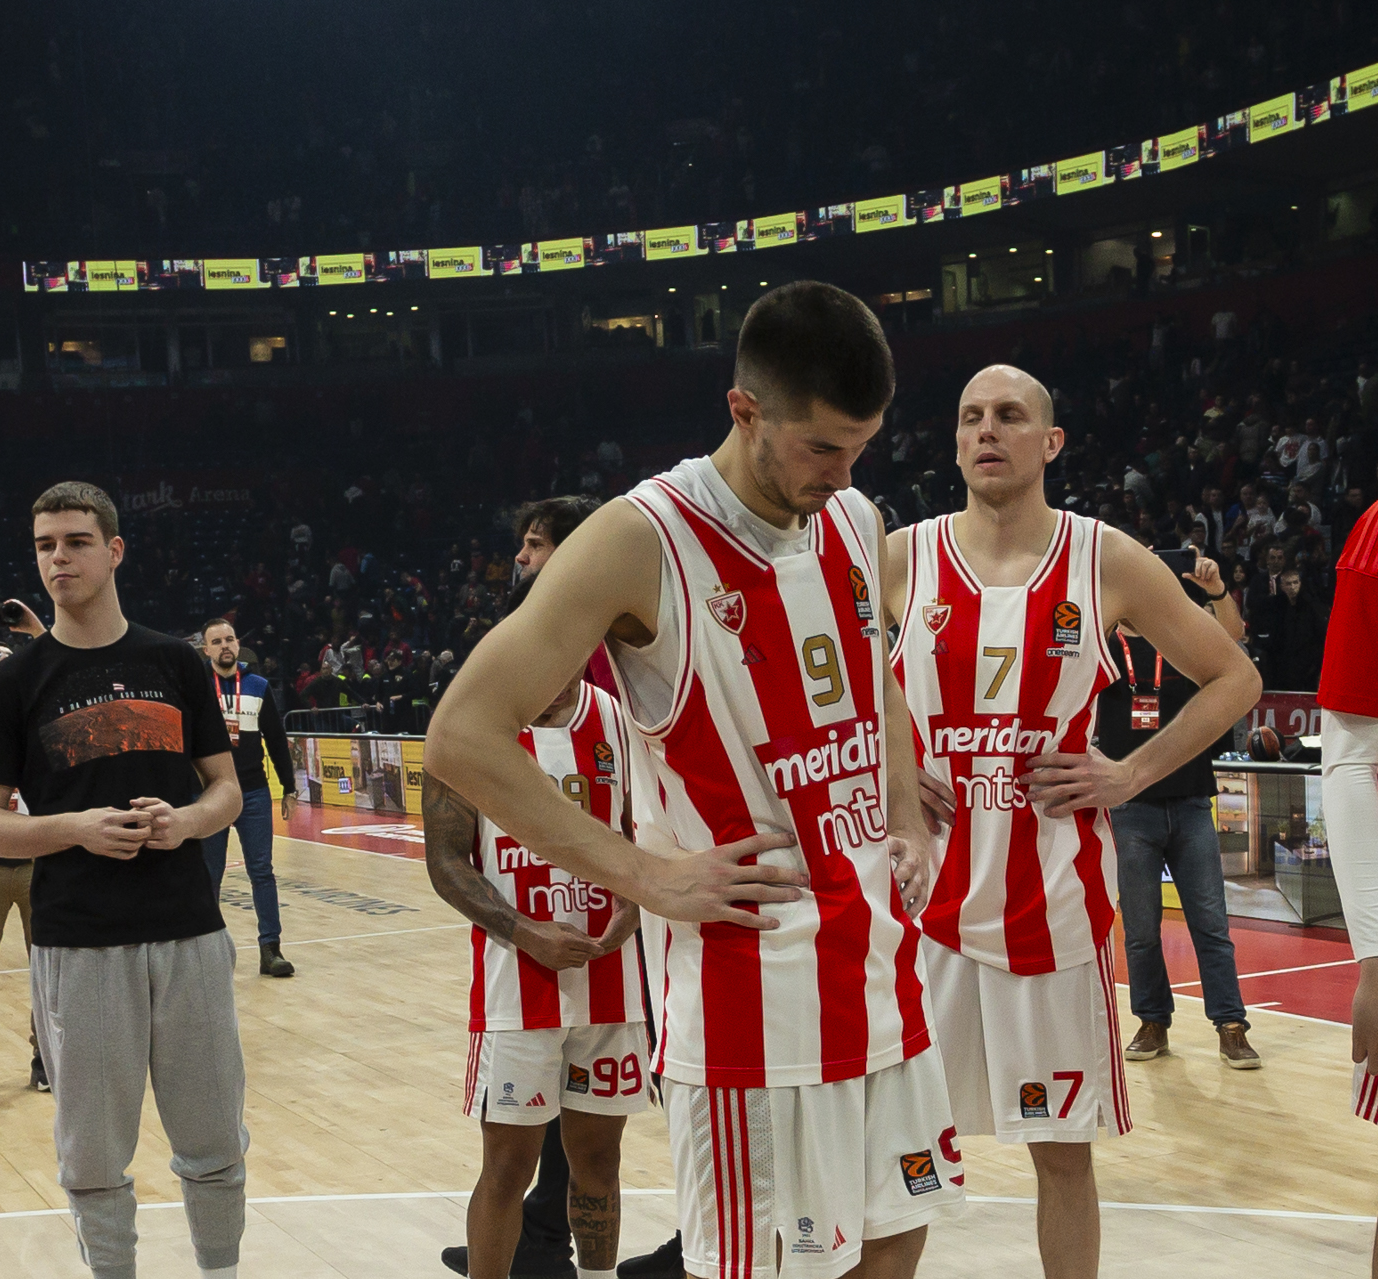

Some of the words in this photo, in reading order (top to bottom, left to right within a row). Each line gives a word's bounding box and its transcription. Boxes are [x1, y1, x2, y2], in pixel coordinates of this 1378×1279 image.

[802, 634, 844, 708] 9
[983, 646, 1017, 701] 7
[529, 876, 607, 913] mts
[591, 1053, 643, 1098] 99
[1052, 1071, 1083, 1119] 7
[909, 1174, 935, 1186] TURKISH
[911, 1179, 937, 1190] AIRLINES
